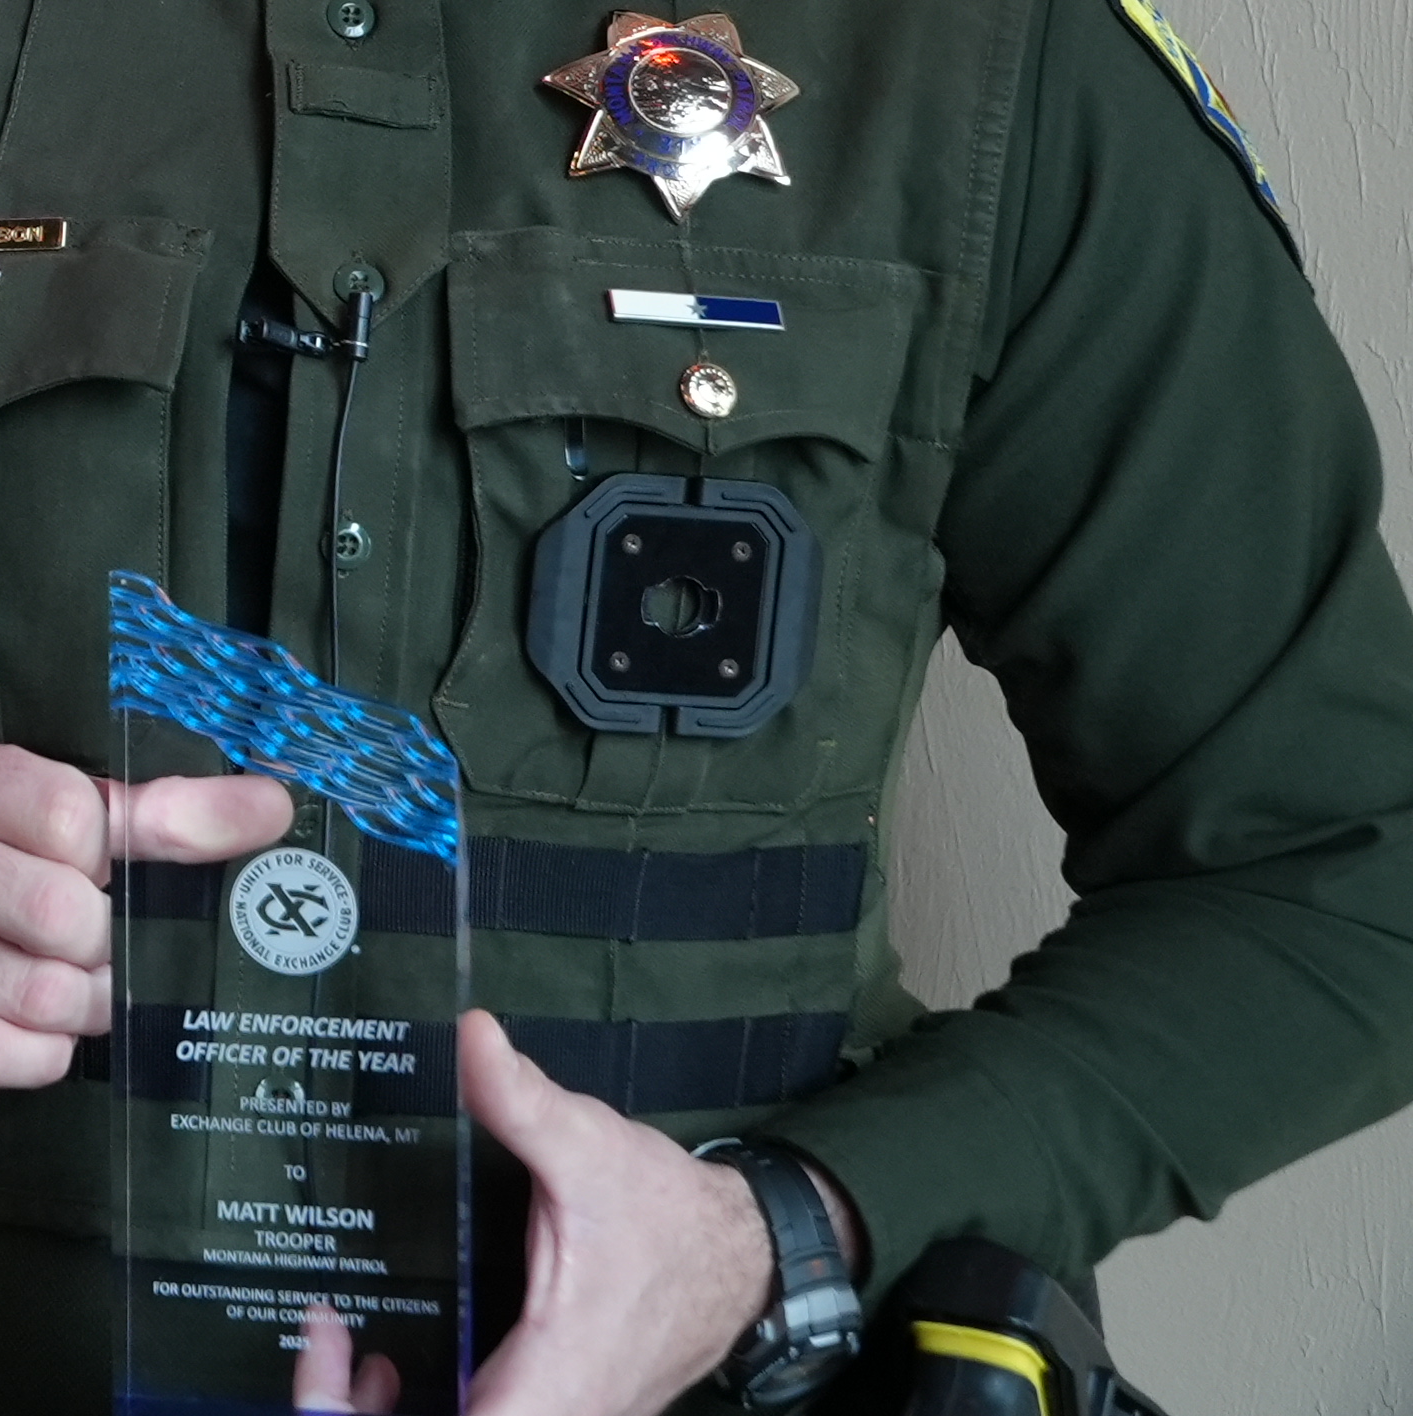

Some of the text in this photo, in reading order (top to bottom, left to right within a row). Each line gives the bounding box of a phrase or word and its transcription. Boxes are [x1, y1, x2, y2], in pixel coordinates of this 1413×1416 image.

[239, 853, 348, 900] UNITY FOR SERVICE
[235, 901, 351, 969] NATIONAL EXCHANGE CLUB
[183, 1009, 410, 1041] LAW ENFORCEMENT
[176, 1040, 416, 1074] OFFICER OF THE YEAR
[240, 1096, 351, 1117] PRESENTED BY
[171, 1114, 421, 1144] EXCHANGE CLUB OF HELENA, MT
[284, 1164, 306, 1180] TO
[218, 1200, 375, 1231] MATT WILSON
[255, 1229, 336, 1252] TROOPER
[203, 1249, 388, 1275] MONTANA HIGHWAY PATROL
[153, 1281, 441, 1315] FOR OUTSTANDING SERVICE TO THE CITIZENS
[226, 1304, 366, 1328] OF OUR COMMUNITY
